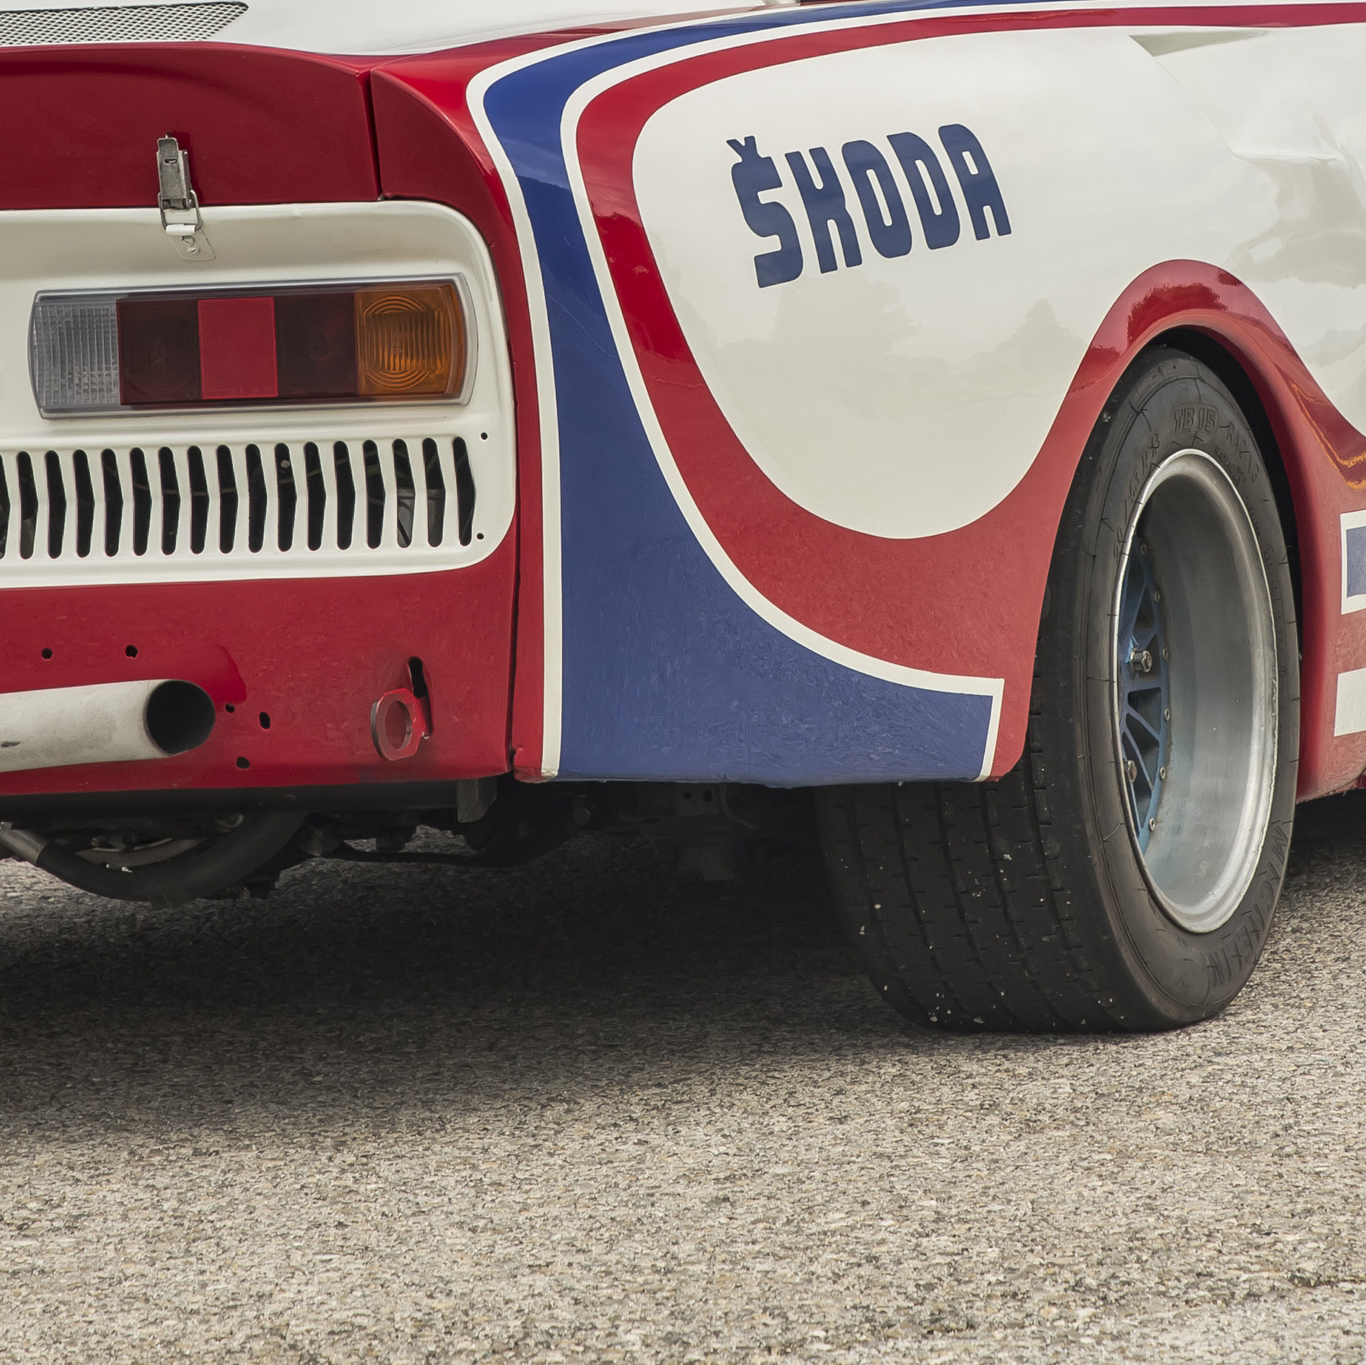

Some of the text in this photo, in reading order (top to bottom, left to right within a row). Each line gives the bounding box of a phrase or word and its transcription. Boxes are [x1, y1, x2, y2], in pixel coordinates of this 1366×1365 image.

[726, 123, 1012, 288] ŠKODA
[1173, 407, 1216, 433] TB 15
[1207, 825, 1289, 986] MICHELIN
